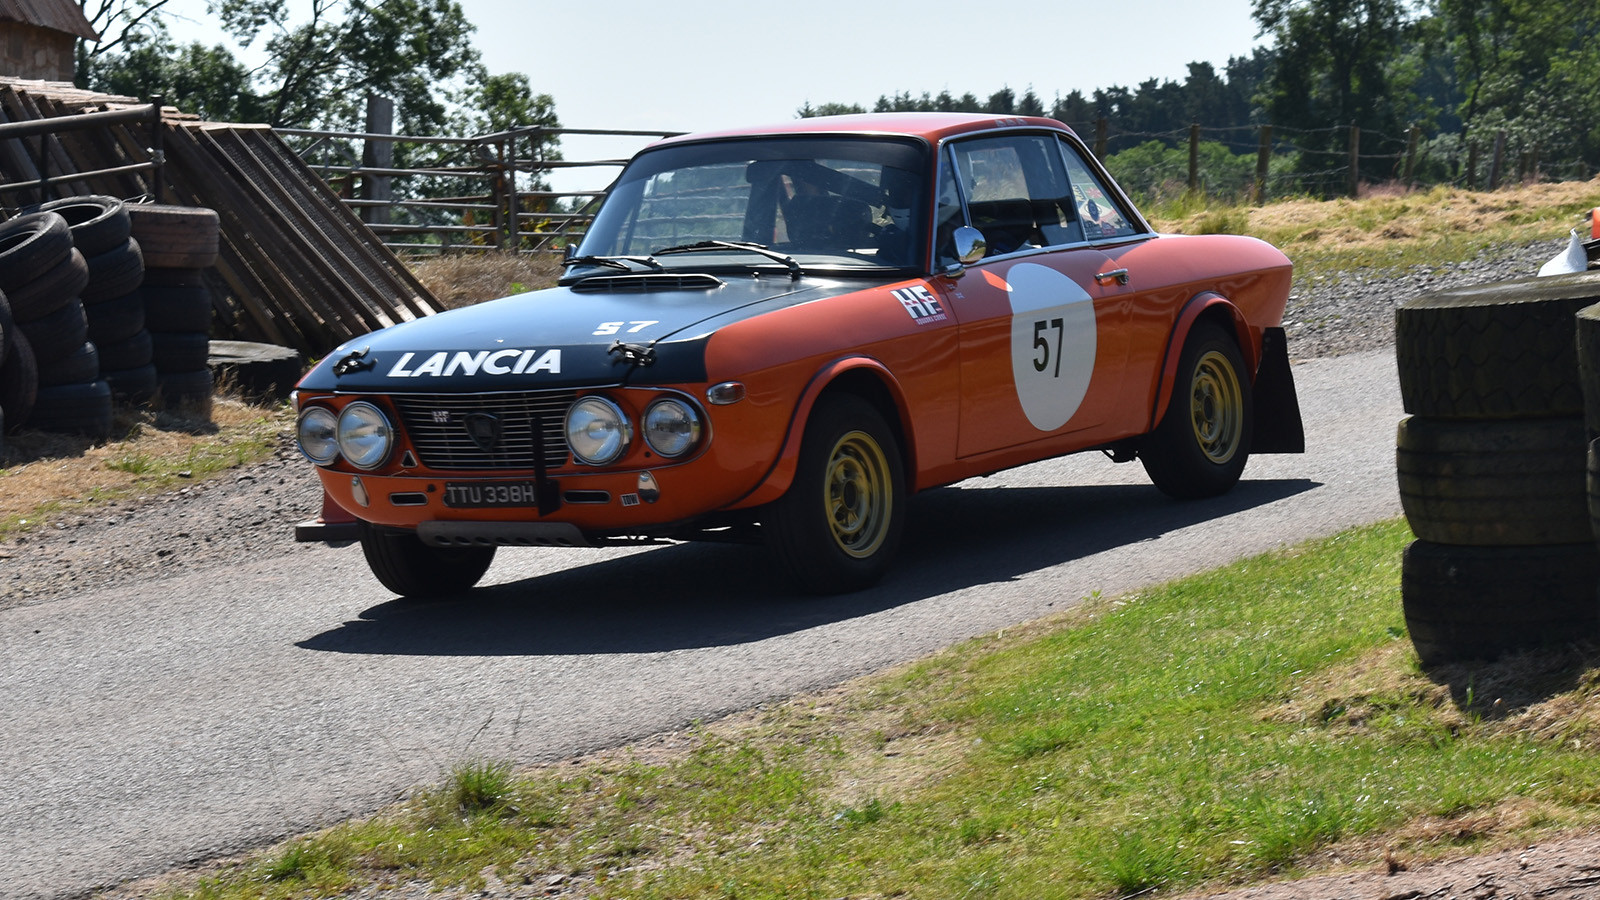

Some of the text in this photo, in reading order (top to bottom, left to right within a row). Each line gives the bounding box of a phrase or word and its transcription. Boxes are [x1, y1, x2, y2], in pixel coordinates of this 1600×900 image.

[890, 284, 938, 319] HF
[592, 321, 659, 335] 57
[1033, 318, 1064, 378] 57
[387, 349, 561, 377] LANCIA
[446, 485, 535, 503] TTU 338H
[621, 494, 639, 505] TOW
